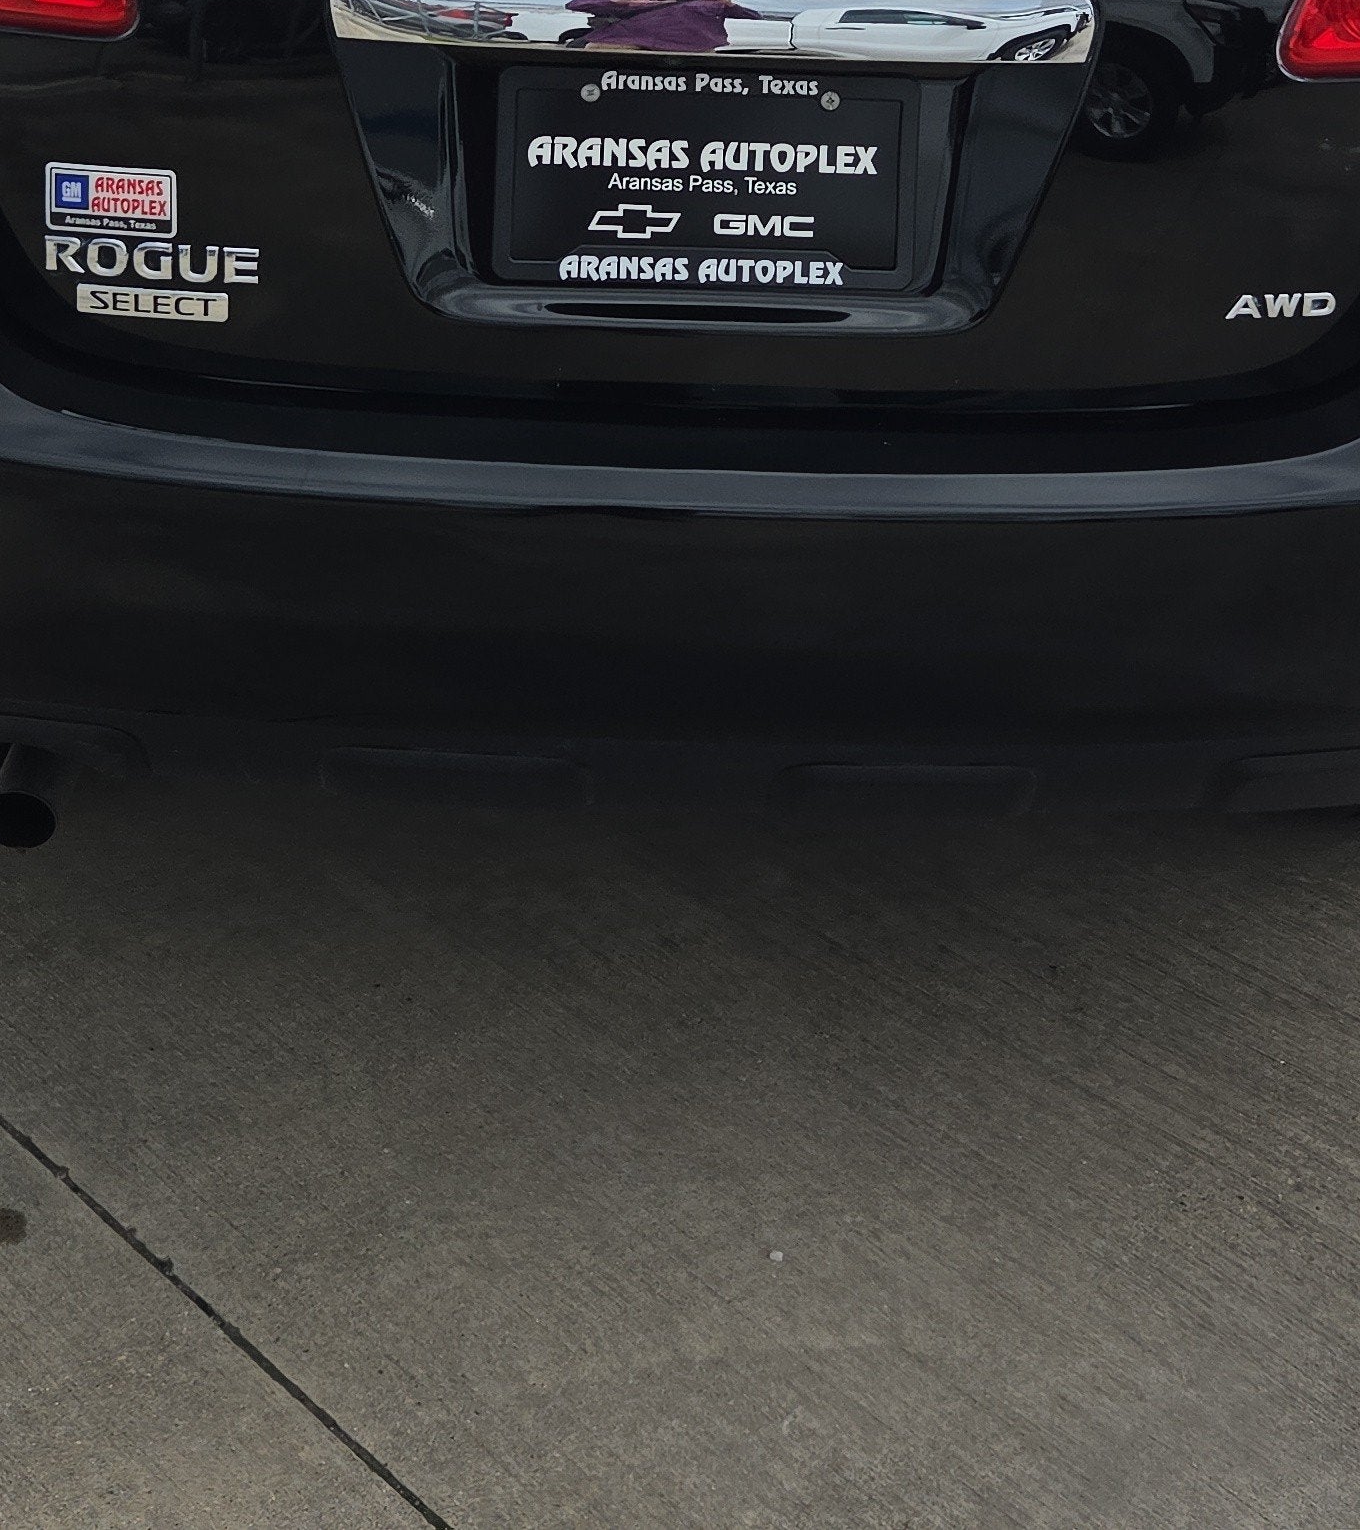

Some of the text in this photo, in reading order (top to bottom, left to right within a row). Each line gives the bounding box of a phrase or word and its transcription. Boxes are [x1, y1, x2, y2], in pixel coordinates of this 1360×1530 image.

[601, 70, 819, 96] Aransas Pass, Texas
[527, 135, 878, 175] ARANSAS AUTOPLEX
[61, 176, 164, 200] GM ARANSAS
[608, 172, 798, 196] Aransas Pass, Texas
[91, 196, 167, 217] AUTOPLEX
[64, 215, 102, 227] Aransas
[130, 219, 157, 231] Texas
[713, 213, 815, 238] GMC
[44, 234, 260, 285] ROGUE
[559, 254, 844, 286] ARANSAS AUTOPLEX
[89, 290, 218, 317] SELECT
[1224, 292, 1337, 320] AWD
